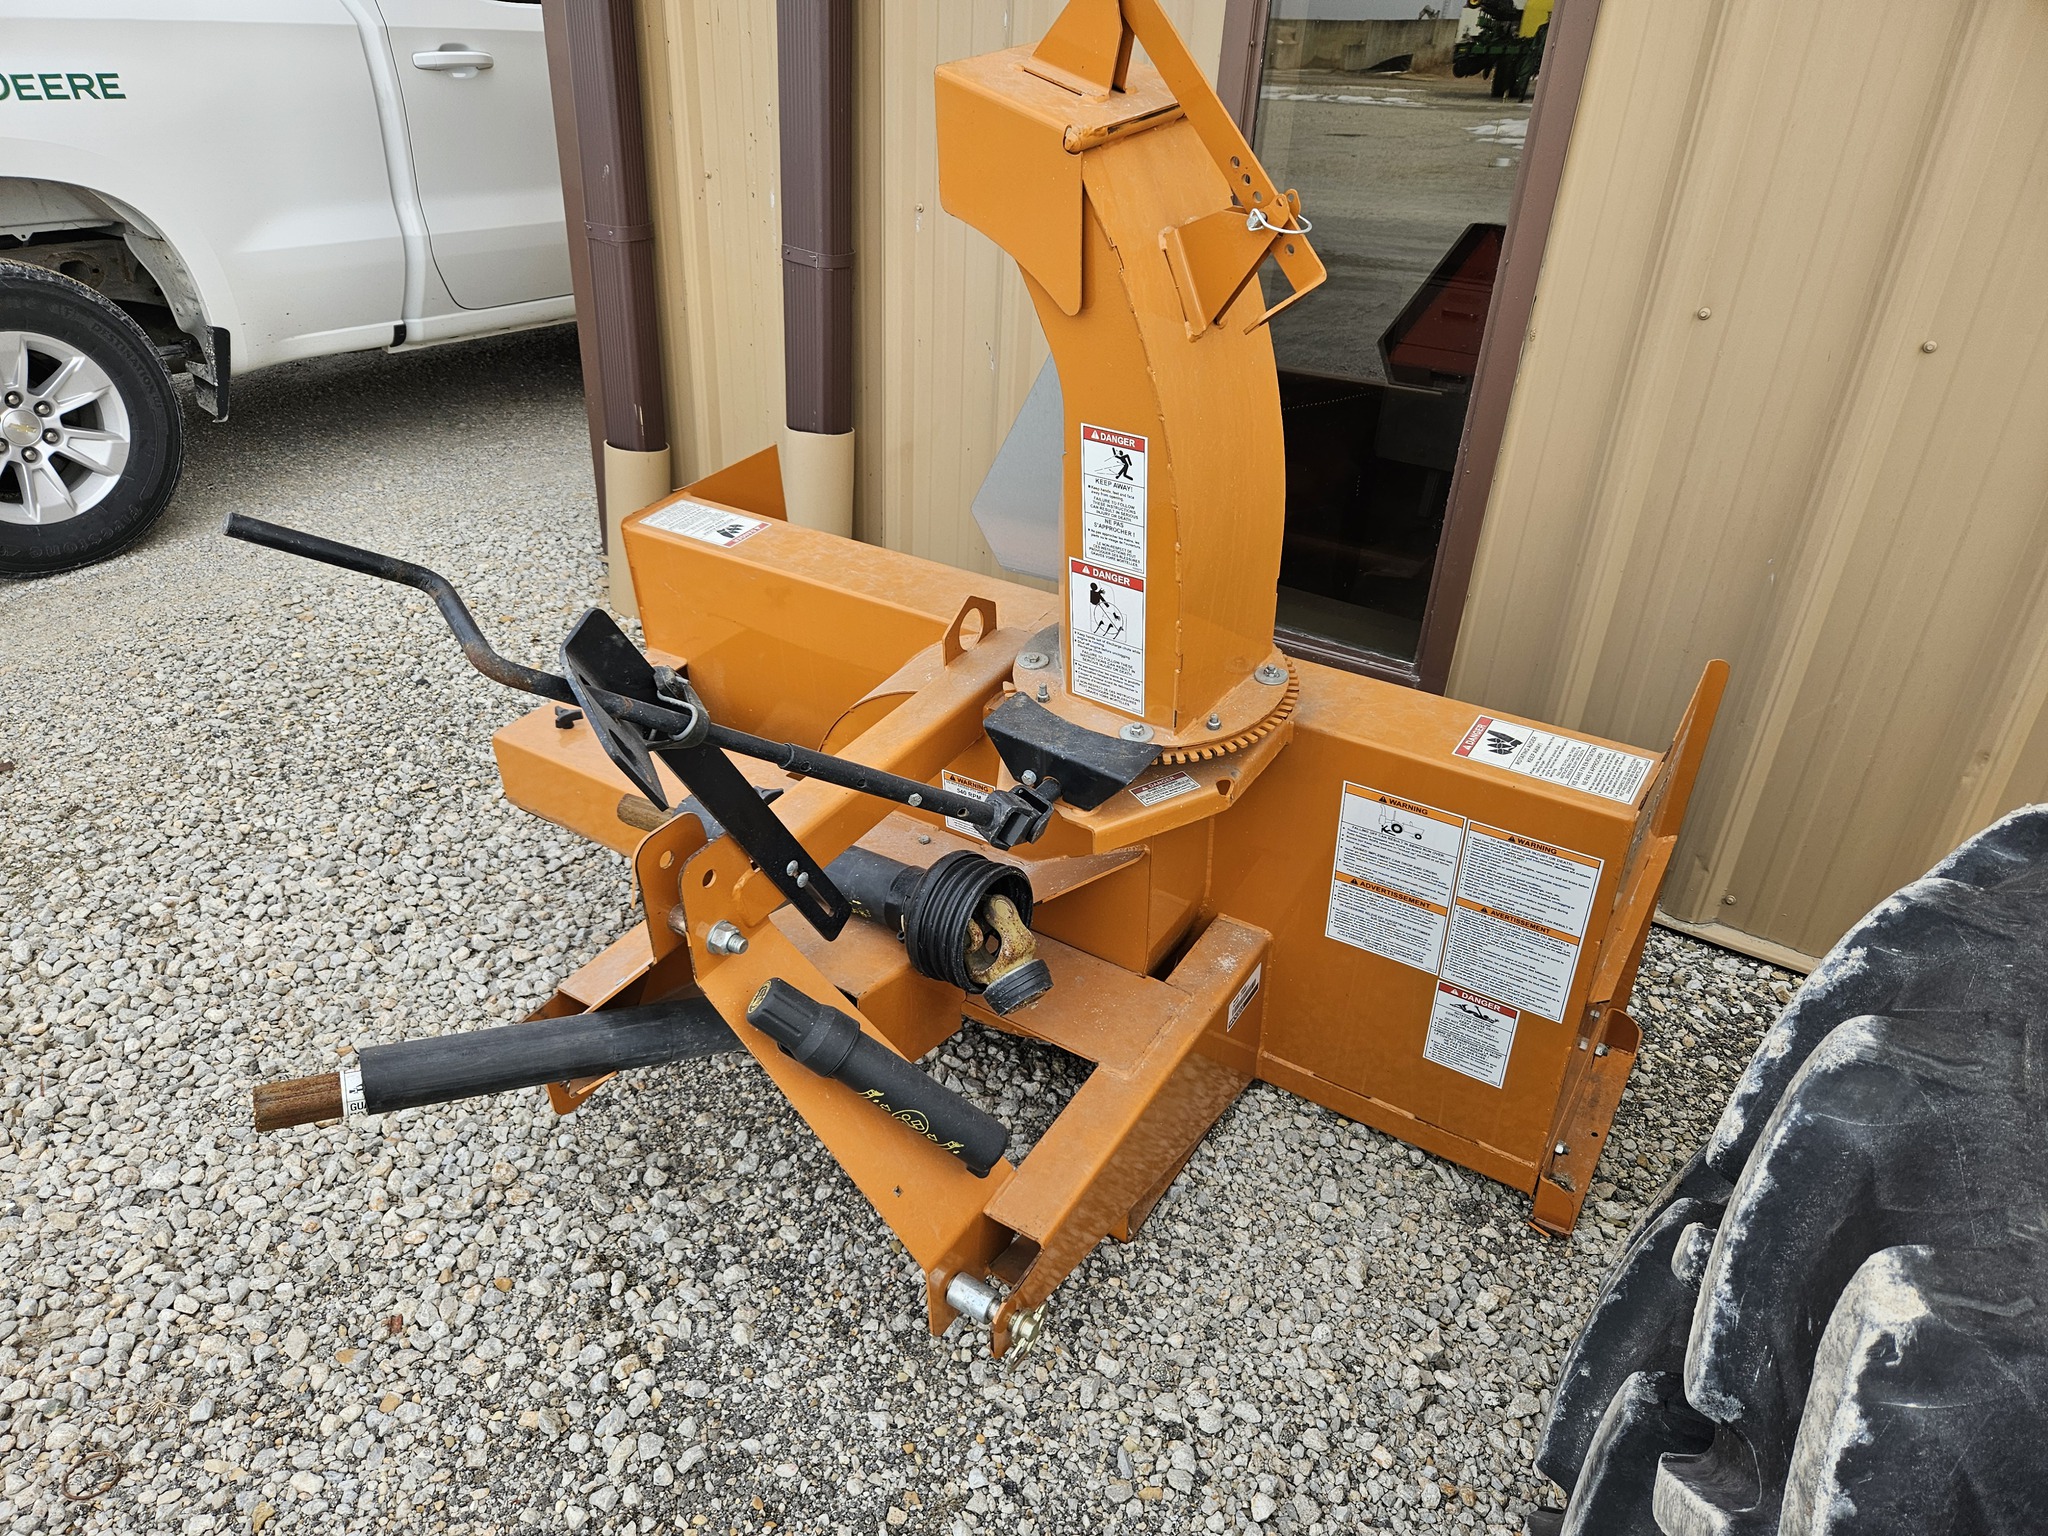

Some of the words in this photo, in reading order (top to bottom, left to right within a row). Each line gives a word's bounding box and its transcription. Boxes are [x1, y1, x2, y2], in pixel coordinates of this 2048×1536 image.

[1100, 433, 1135, 448] DANGER
[1095, 477, 1112, 487] KEEP
[1113, 482, 1132, 493] AWAY!
[1094, 495, 1110, 504] FAILURE
[1117, 502, 1135, 510] FOLLOW
[1100, 506, 1115, 514] RESULT
[1121, 511, 1138, 520] SERIOUS
[1094, 521, 1132, 537] S'APPROCHER
[1113, 521, 1124, 529] PAS
[1093, 569, 1130, 586] DANGER
[1465, 723, 1487, 745] DANGER
[1515, 748, 1530, 765] ROTATING
[1526, 736, 1538, 748] AUGER
[1531, 742, 1543, 754] AWAY!
[1526, 753, 1537, 763] KEEP
[957, 776, 989, 793] WARNING
[1148, 776, 1175, 787] DANGER
[968, 791, 982, 800] RPM
[1389, 798, 1429, 816] WARNING
[1517, 838, 1558, 855] WARNING
[1360, 881, 1431, 909] ADVERTISSEMENT
[1491, 910, 1551, 935] AVERTISSEMENT
[1461, 992, 1501, 1012] DANGER
